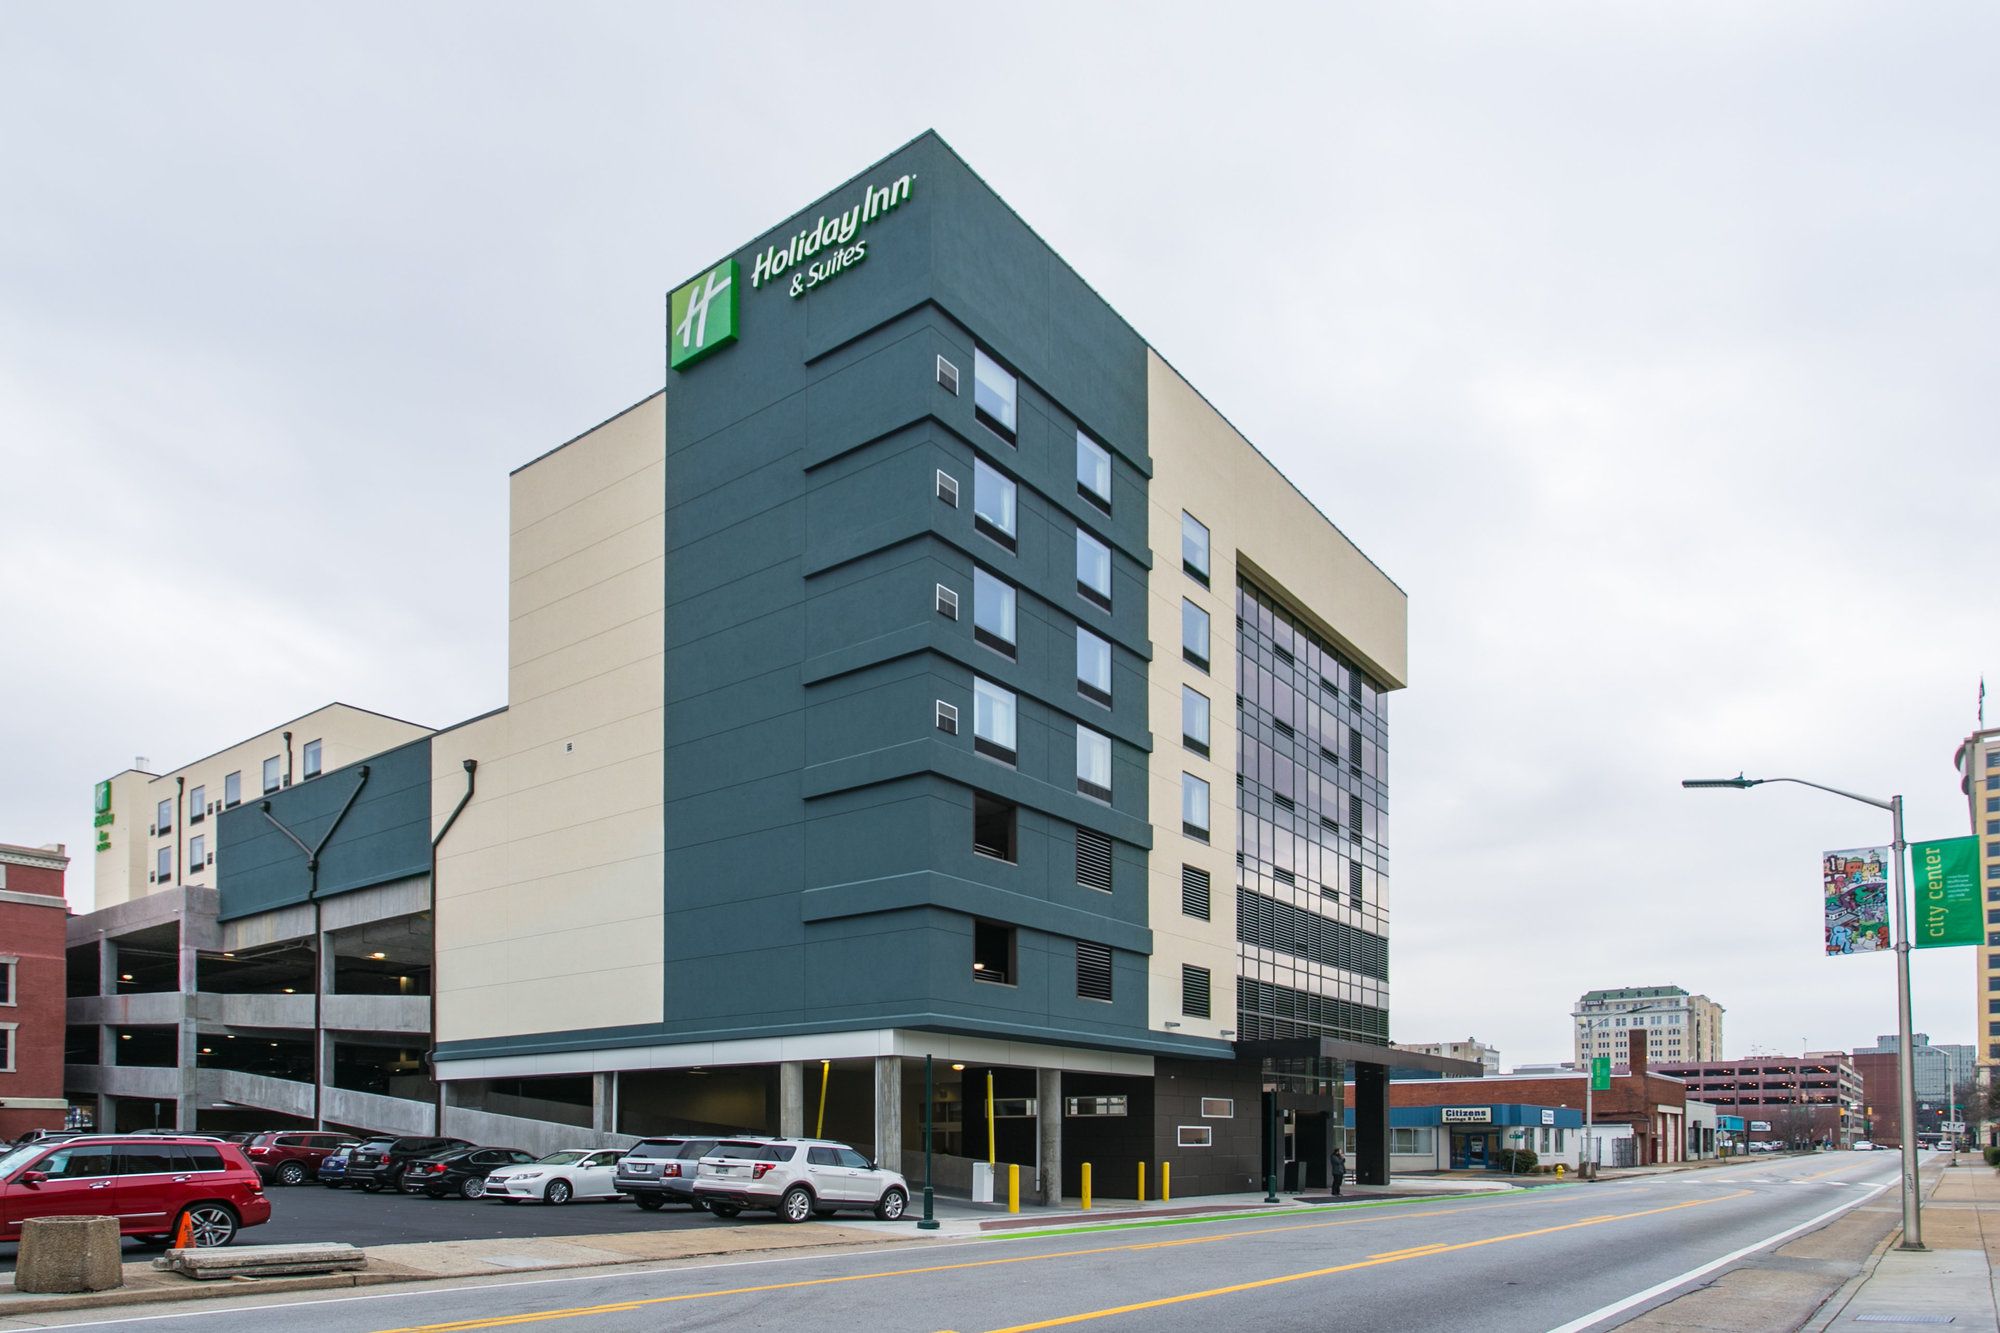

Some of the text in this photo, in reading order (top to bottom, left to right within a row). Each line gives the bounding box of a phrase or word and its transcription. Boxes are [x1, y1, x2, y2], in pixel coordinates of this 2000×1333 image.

[751, 174, 910, 288] Holiday Inn
[789, 240, 867, 297] & Suites
[1925, 847, 1949, 937] city center
[1445, 1109, 1487, 1117] Citizens
